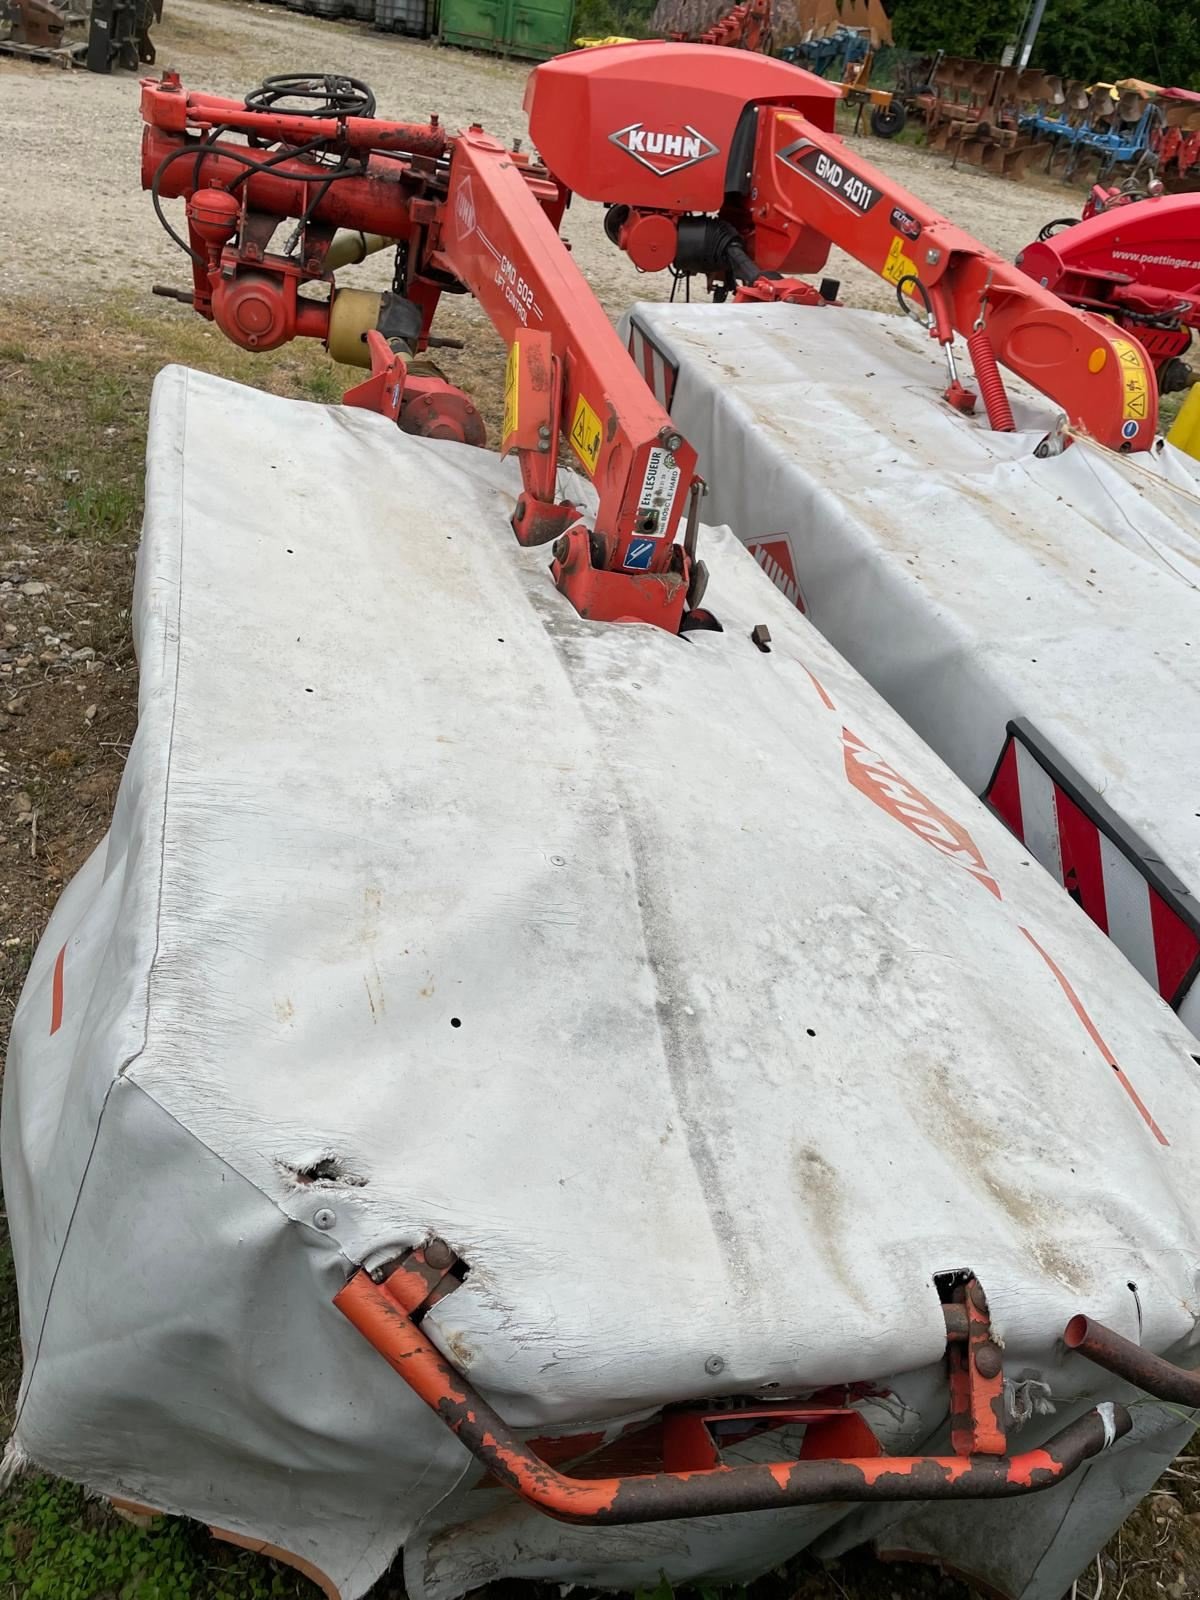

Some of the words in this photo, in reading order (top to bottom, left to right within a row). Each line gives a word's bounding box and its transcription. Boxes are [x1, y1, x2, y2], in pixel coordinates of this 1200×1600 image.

[628, 130, 701, 158] KUHN
[815, 154, 843, 188] GMD
[843, 177, 873, 210] 4011
[494, 270, 505, 292] LIFT
[505, 286, 528, 327] CONTROL
[501, 255, 517, 286] GMD
[516, 279, 534, 310] 602
[645, 451, 662, 491] LESUEUR
[669, 471, 679, 491] HARD
